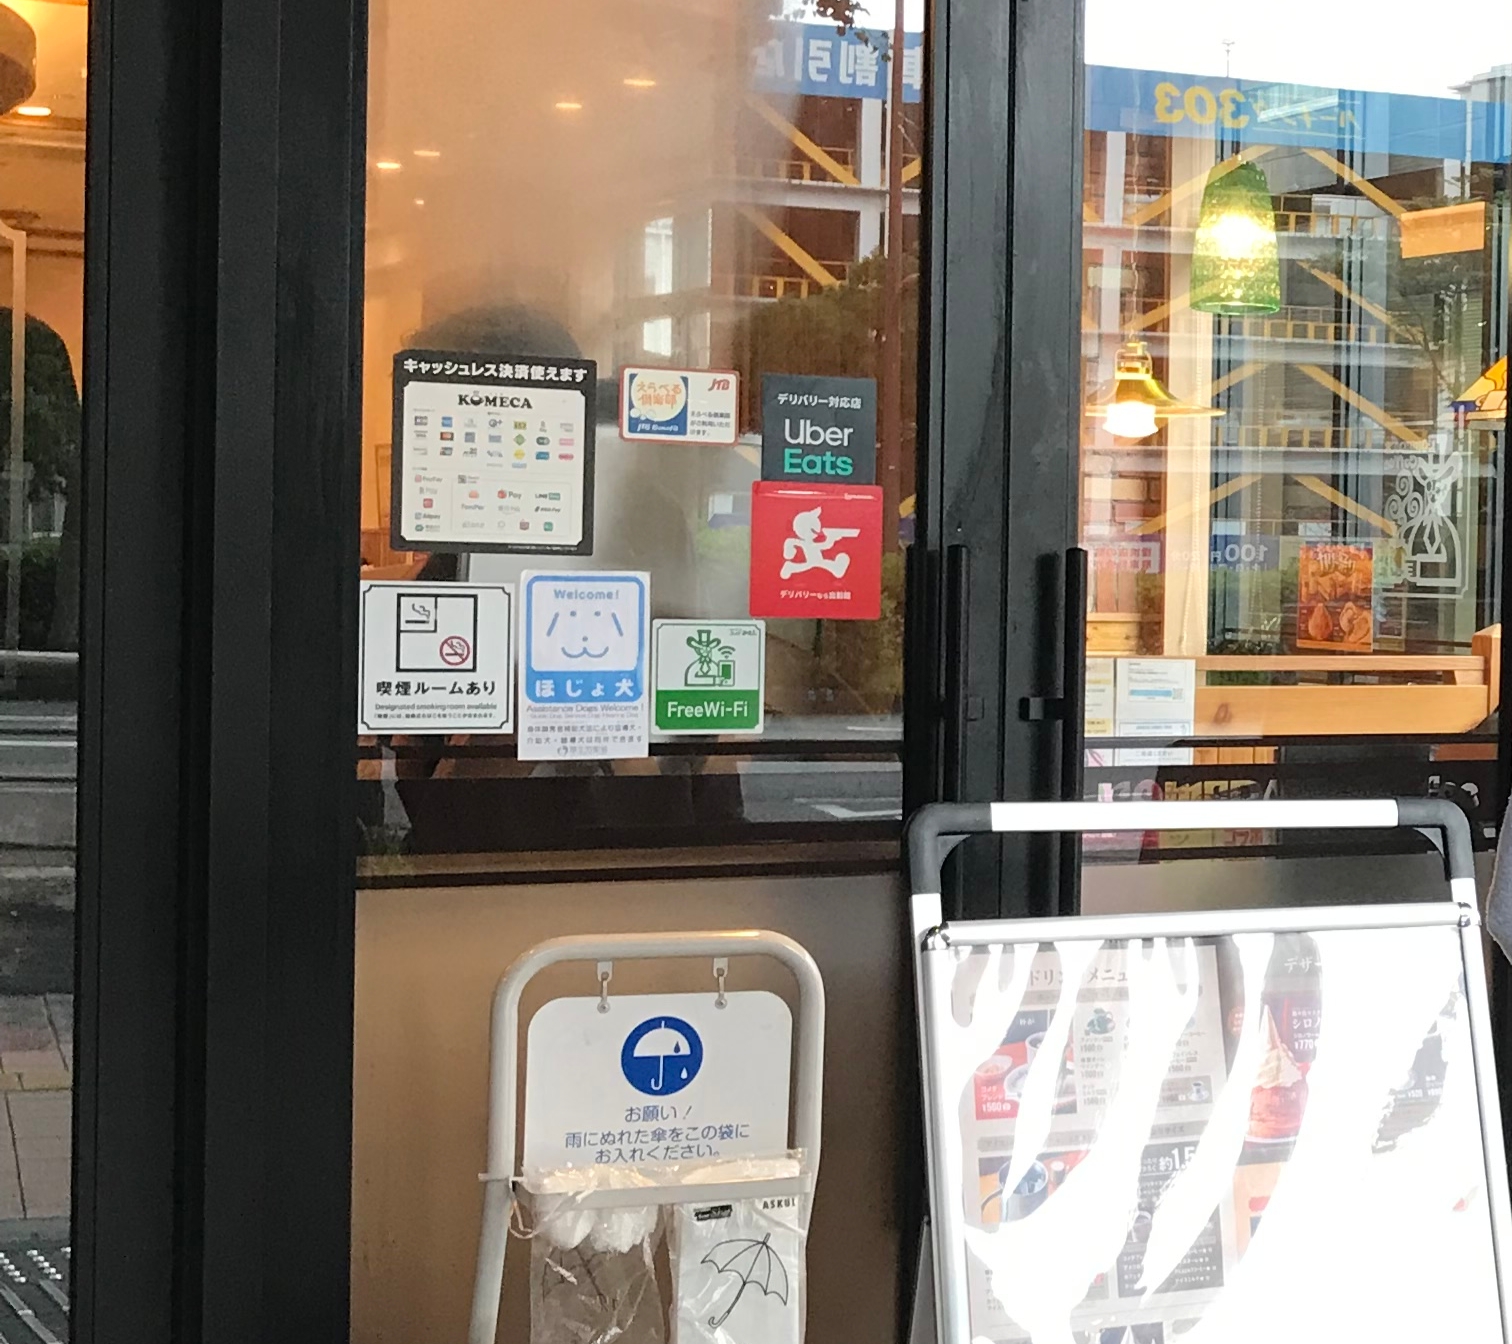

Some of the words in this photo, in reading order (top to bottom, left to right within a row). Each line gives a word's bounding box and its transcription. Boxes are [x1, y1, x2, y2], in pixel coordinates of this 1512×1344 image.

[403, 358, 588, 382] キャッシュレス決済使えます
[707, 378, 731, 392] JTB
[777, 393, 862, 410] デリバリー対応店
[784, 418, 854, 447] Uber
[783, 448, 854, 476] Eats
[553, 588, 620, 600] Welcome!
[376, 681, 497, 696] 喫煙ルームあり
[535, 678, 635, 697] ほじょ犬
[1284, 957, 1321, 973] デザー
[565, 1123, 750, 1148] 雨にぬれた傘をこの袋に
[595, 1144, 720, 1164] お入れください。
